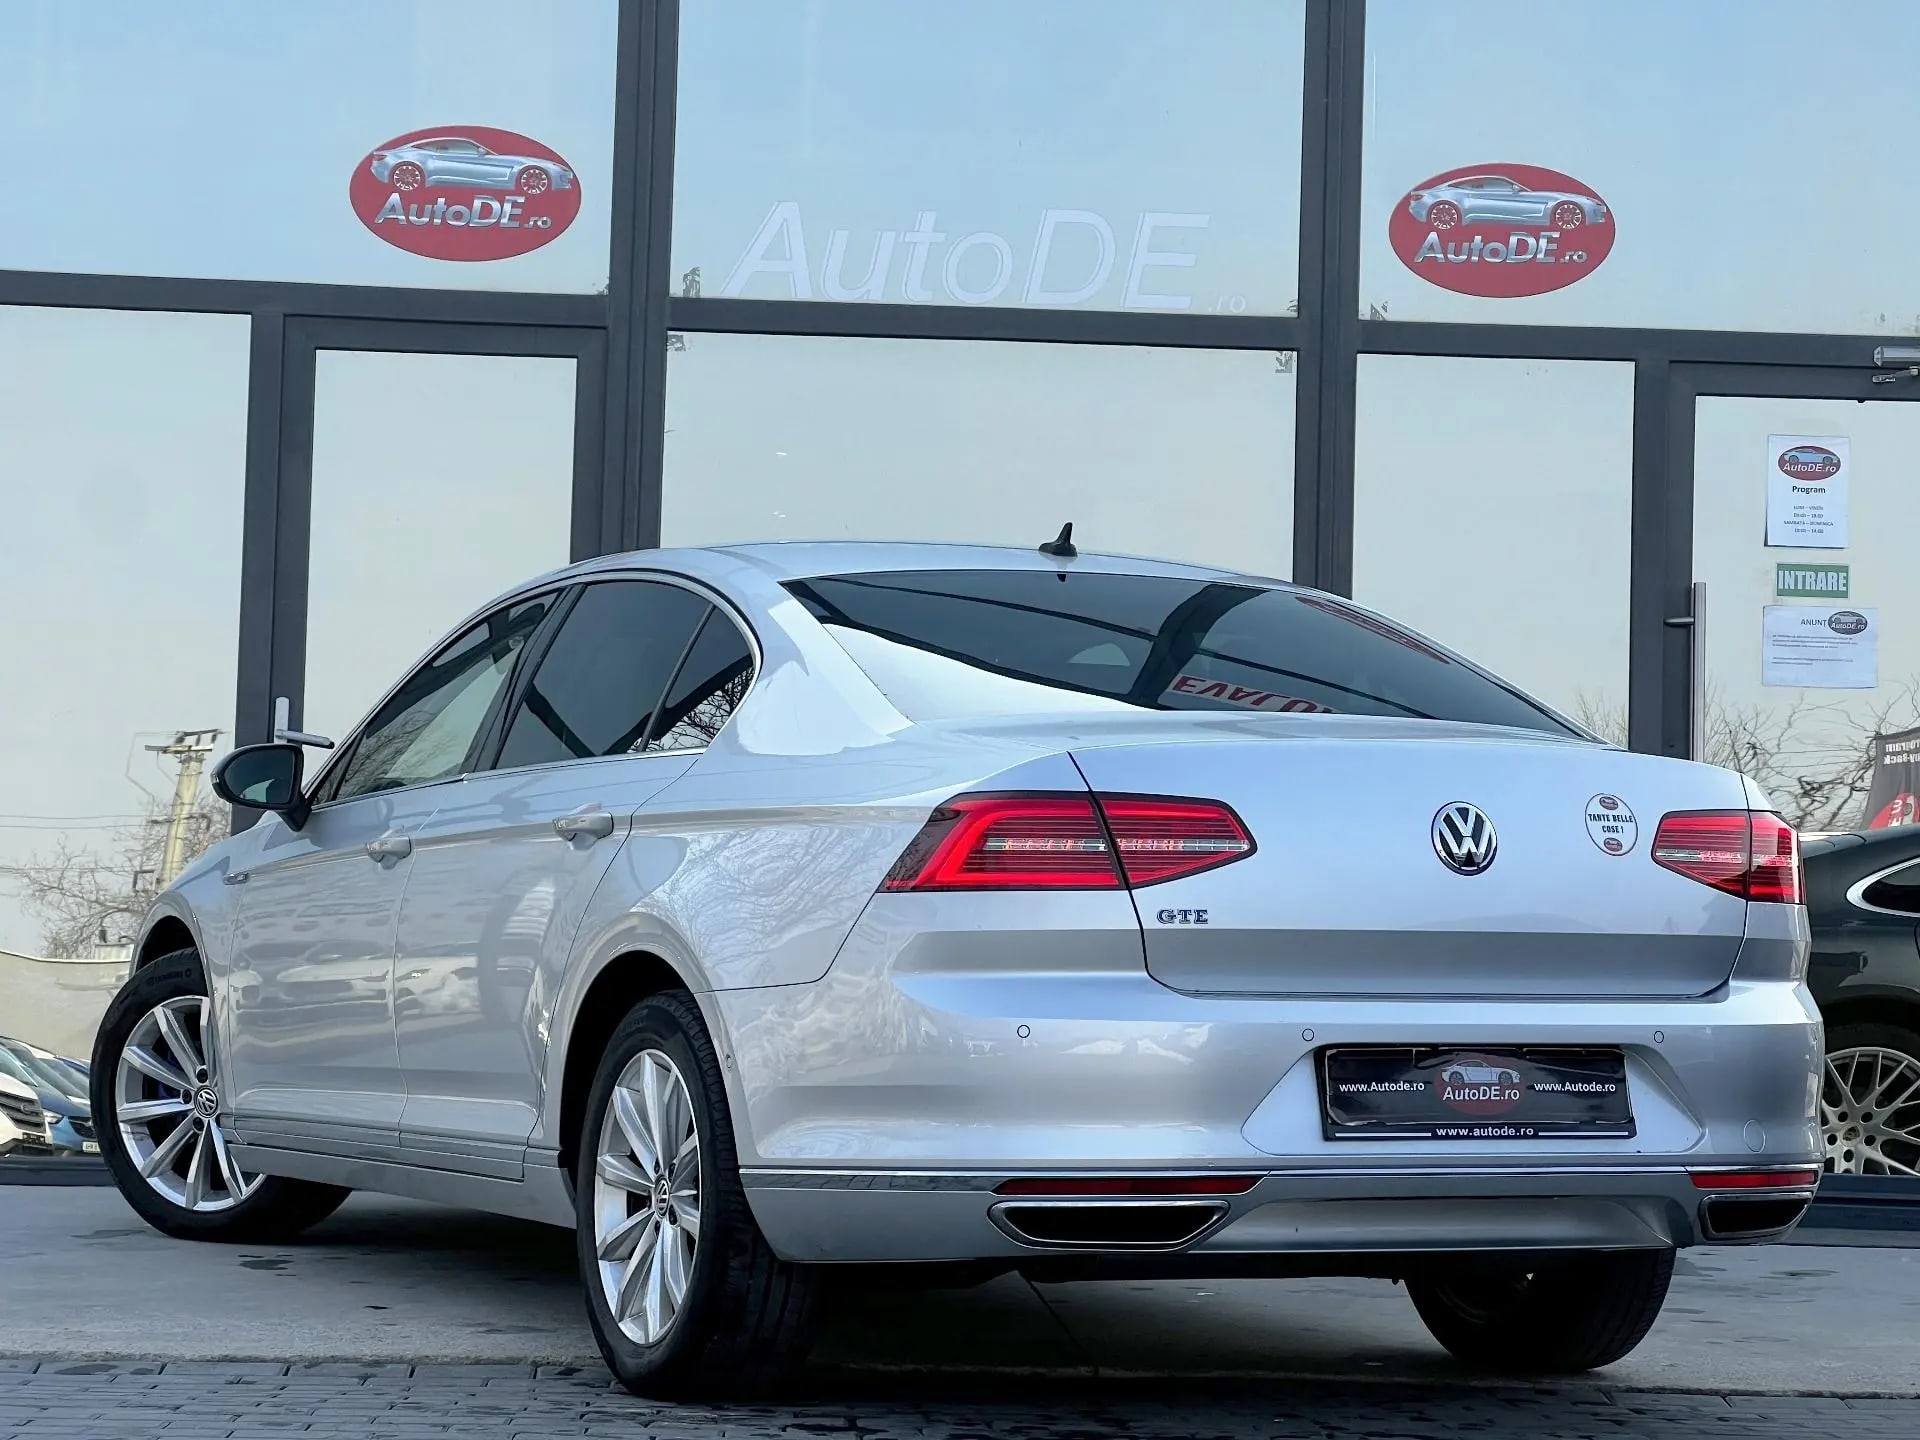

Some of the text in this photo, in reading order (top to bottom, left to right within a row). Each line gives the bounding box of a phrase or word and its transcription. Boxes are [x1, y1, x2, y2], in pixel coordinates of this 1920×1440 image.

[1792, 485, 1826, 494] Program
[1778, 570, 1848, 591] INTRARE
[1587, 813, 1634, 823] TANTE BELLE
[1157, 909, 1208, 924] GTE
[1339, 1081, 1616, 1102] www.Autode.ro AutoDE.ro www.Autode.ro
[1436, 1126, 1534, 1137] www.autode.ro
